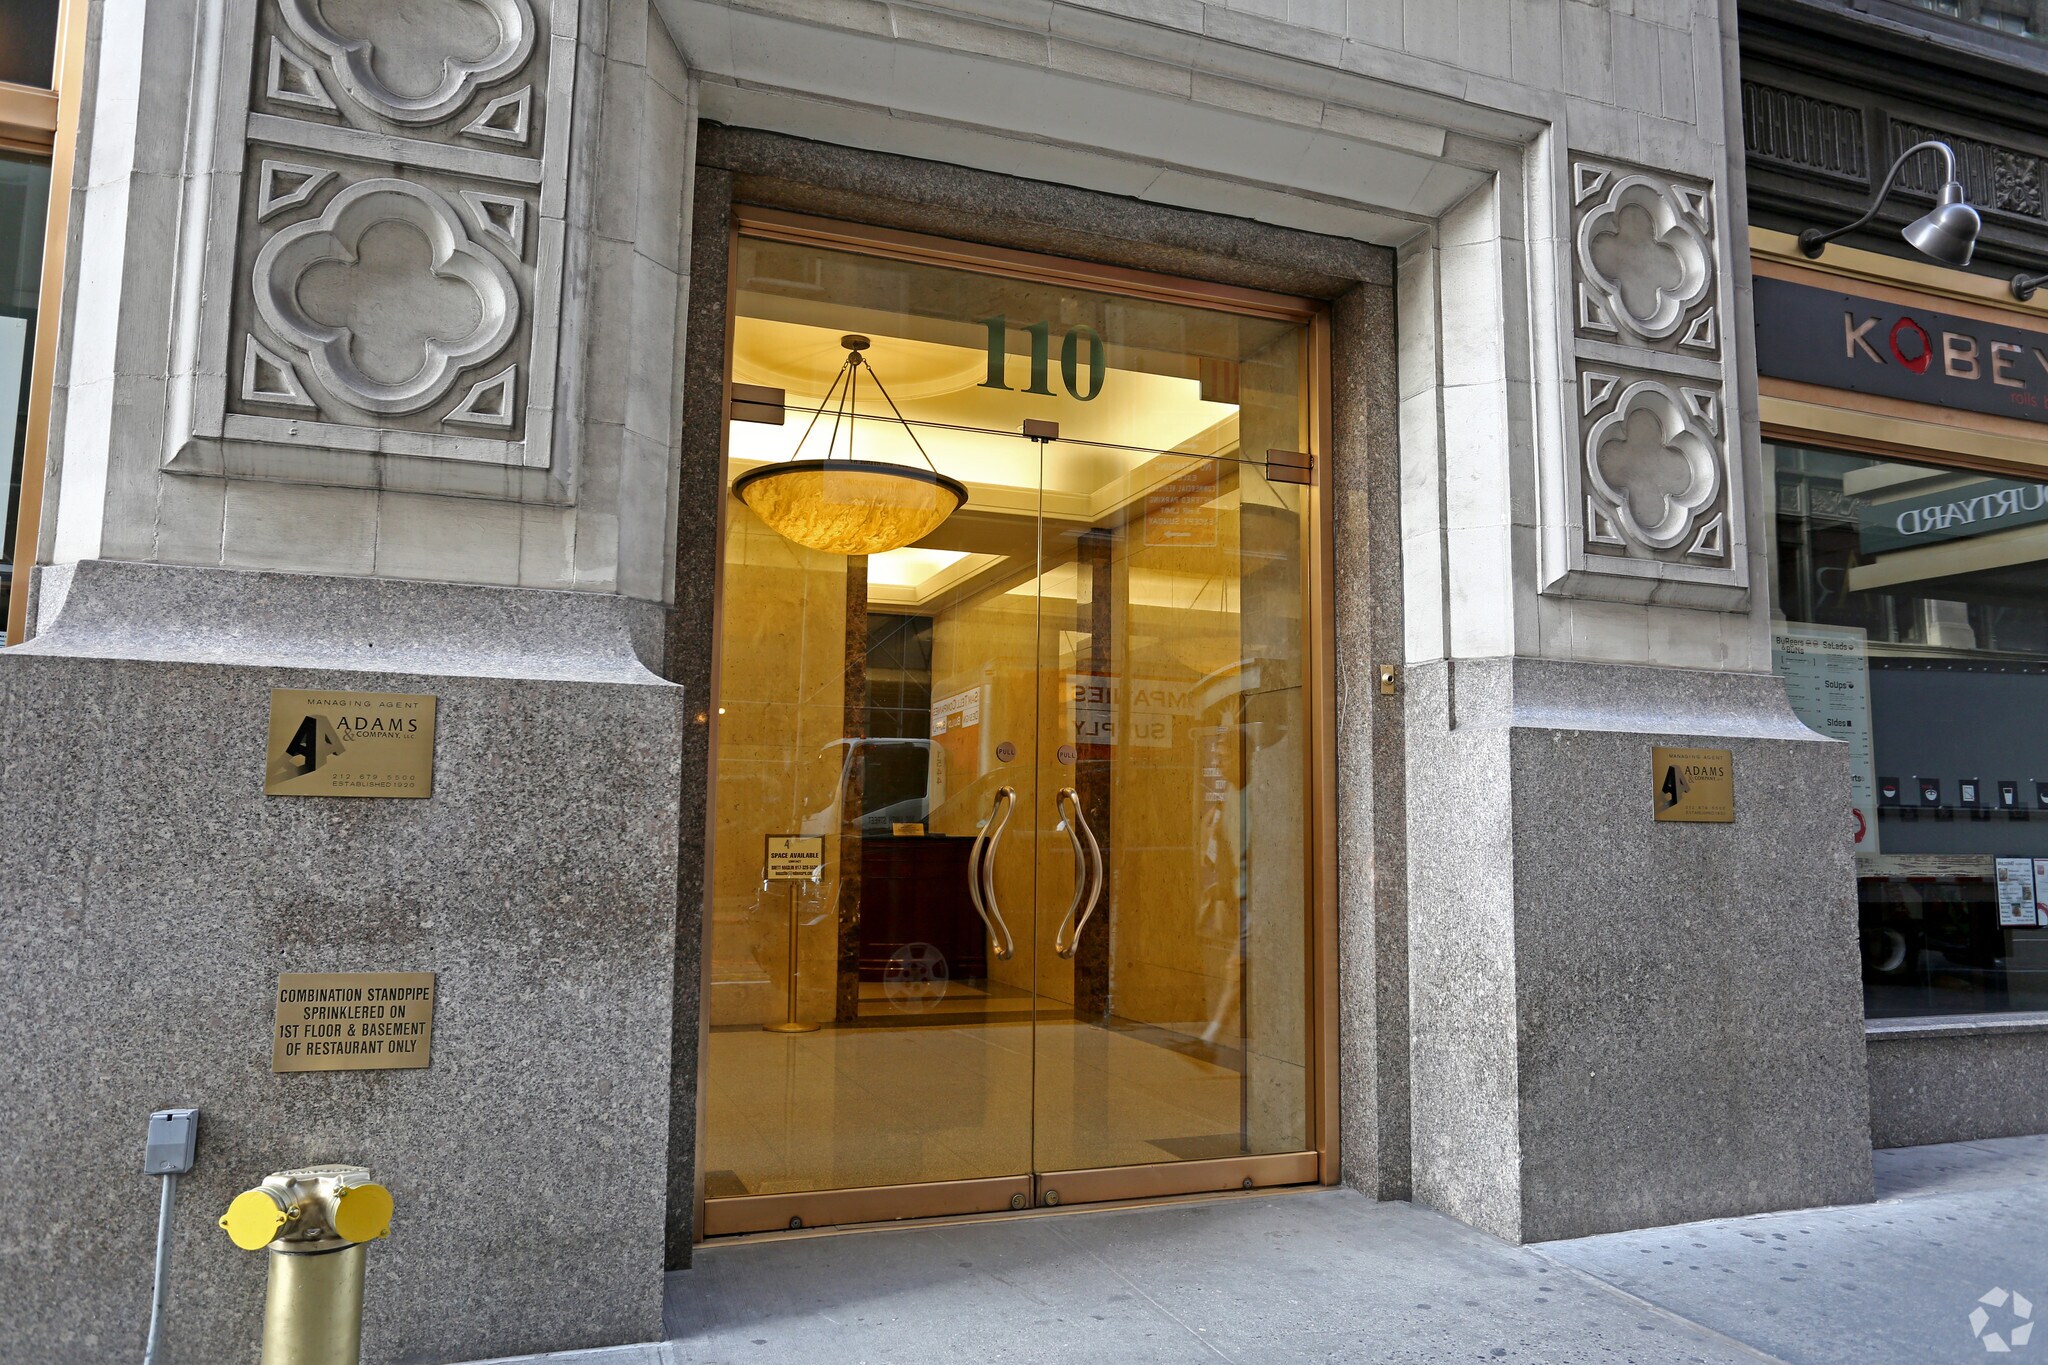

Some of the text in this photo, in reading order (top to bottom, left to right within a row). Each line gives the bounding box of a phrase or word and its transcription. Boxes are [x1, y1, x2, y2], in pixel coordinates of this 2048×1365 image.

[976, 313, 1106, 402] 110
[2010, 391, 2038, 408] rolls
[307, 698, 419, 709] MANAGING AGENT
[336, 716, 418, 732] ADAMS
[342, 728, 355, 742] &
[1059, 750, 1076, 759] PULL
[1685, 766, 1724, 777] ADAMS
[280, 987, 430, 1003] COMBINATION STANDPIPE
[303, 1004, 406, 1020] SPRINKLERED ON
[279, 1022, 426, 1039] 1ST FLOOR & BASEMENT
[286, 1039, 417, 1057] OF RESTAURANT ONLY
